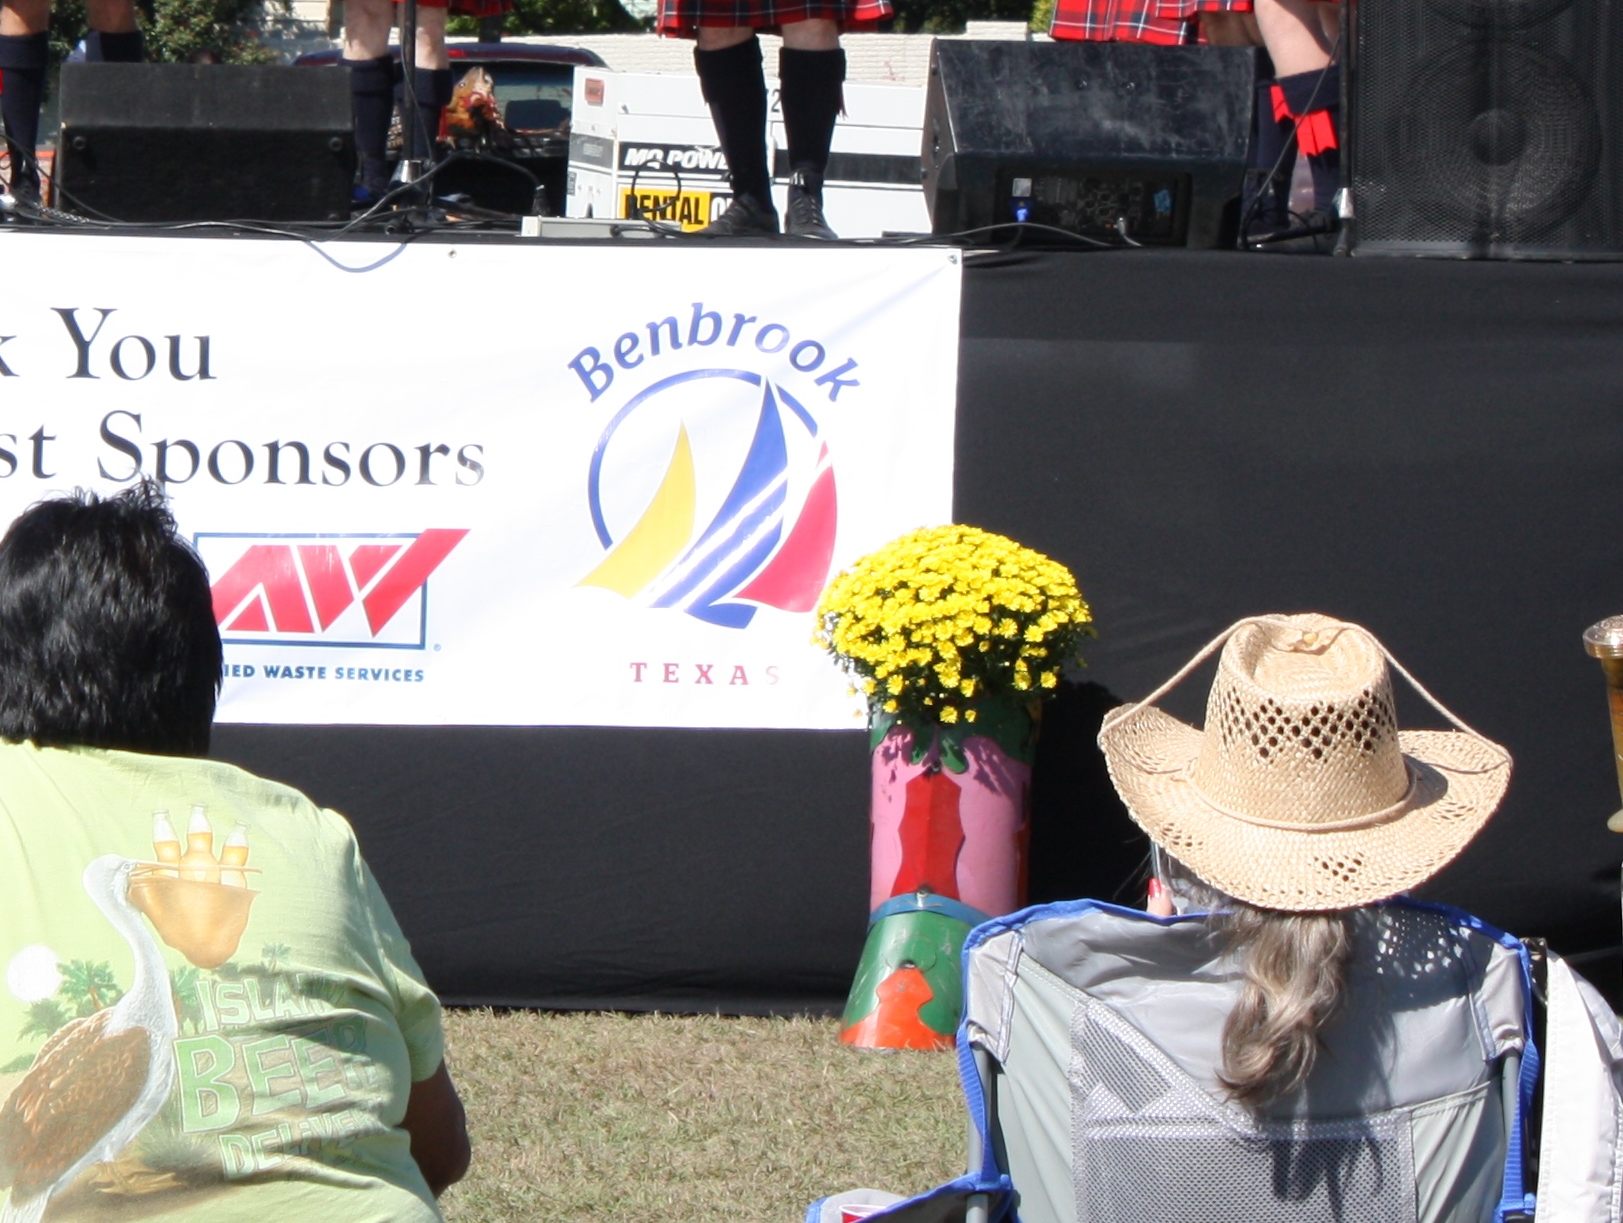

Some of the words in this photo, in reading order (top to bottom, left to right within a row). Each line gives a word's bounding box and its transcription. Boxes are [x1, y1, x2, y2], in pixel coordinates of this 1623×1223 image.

[666, 149, 732, 171] POWE
[50, 307, 218, 382] You
[567, 301, 861, 403] Benbrook
[96, 409, 486, 495] Sponsors
[224, 663, 256, 679] IED
[263, 664, 327, 681] WASTE
[334, 666, 426, 684] SERVICES
[630, 662, 780, 686] TEXAS
